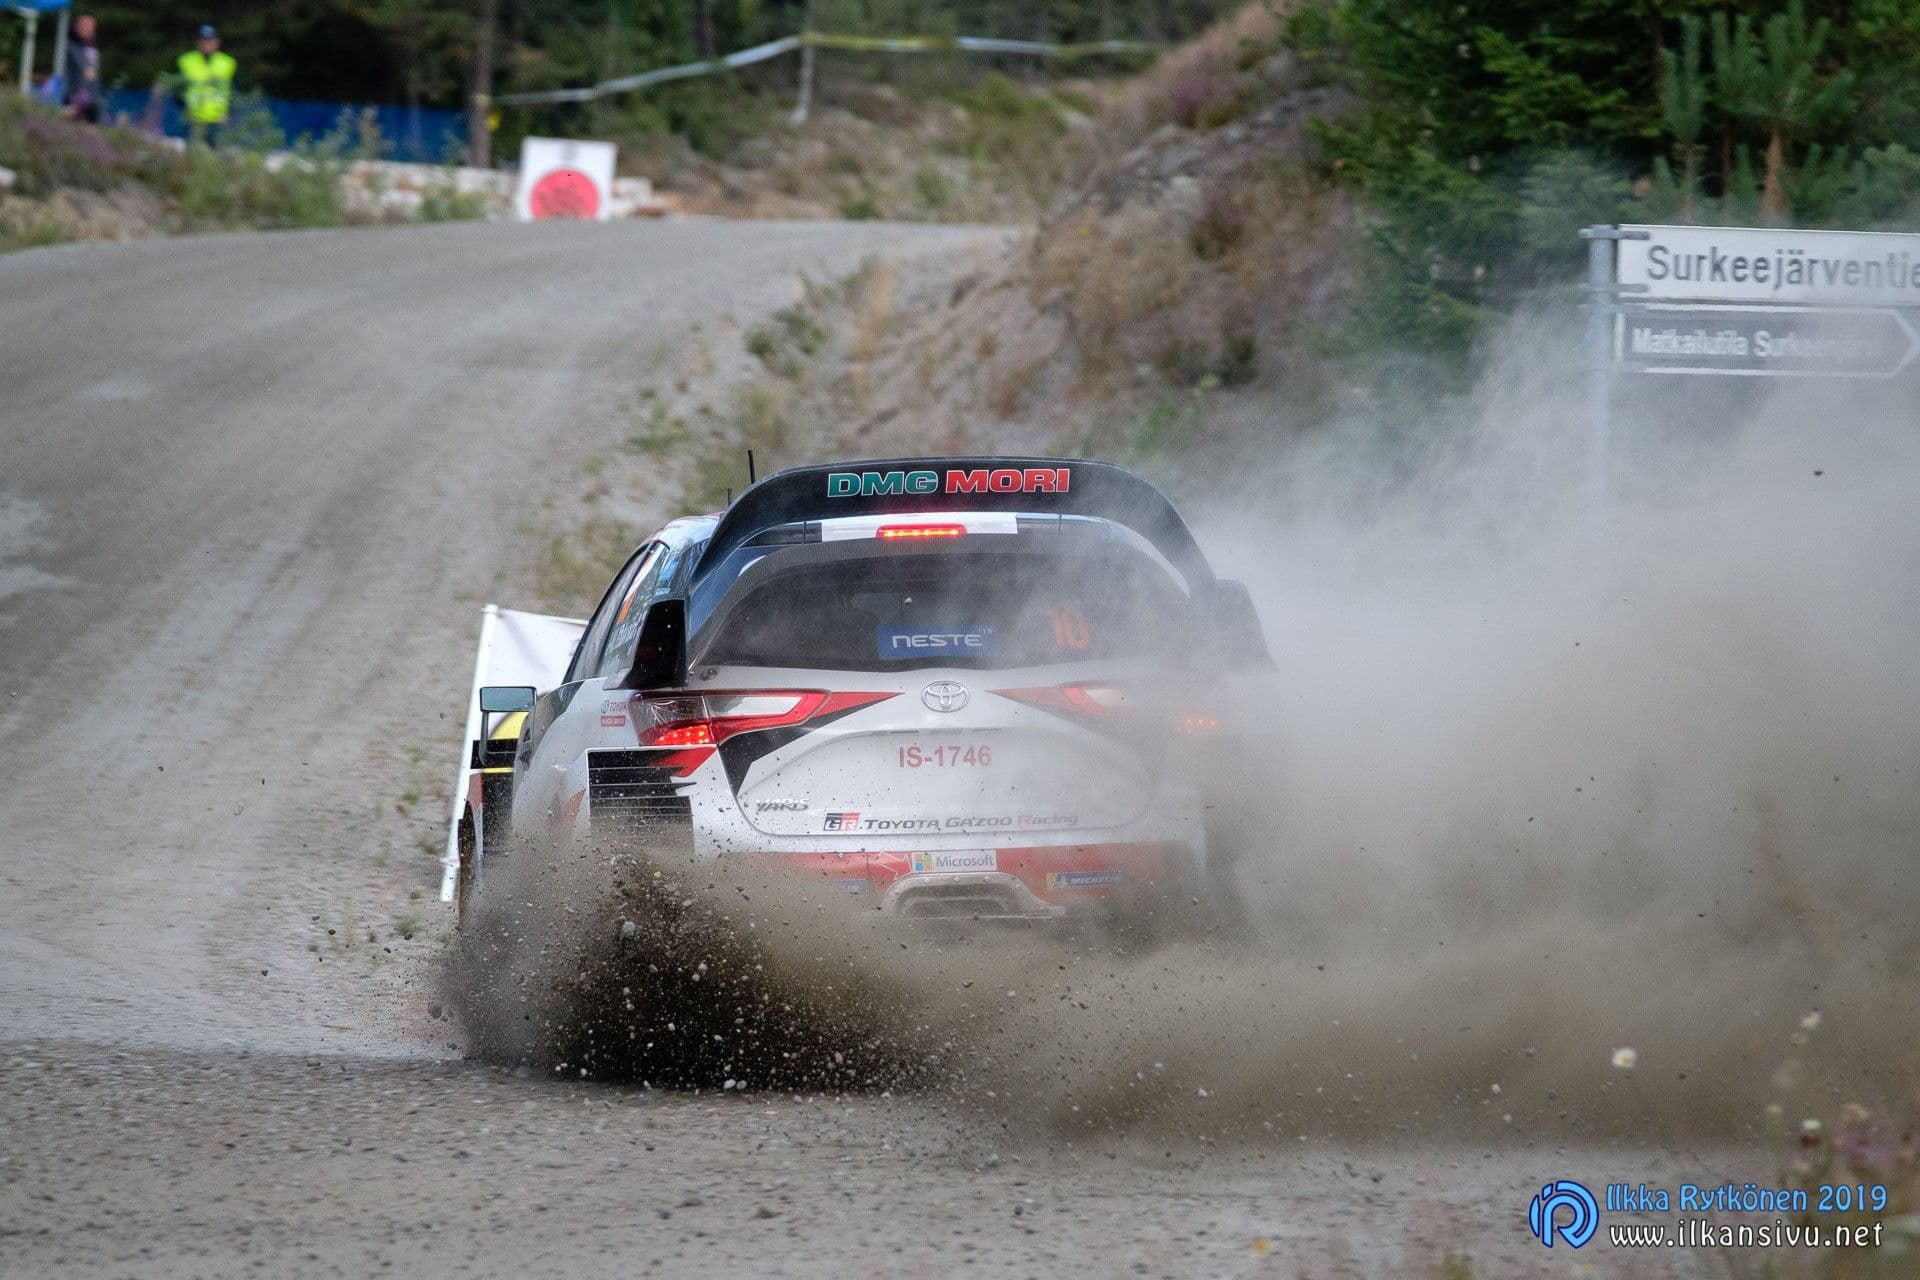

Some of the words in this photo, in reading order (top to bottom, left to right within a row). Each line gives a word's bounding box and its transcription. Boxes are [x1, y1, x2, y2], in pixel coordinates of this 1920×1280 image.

[827, 470, 938, 498] DMG
[945, 468, 1070, 493] MORI
[897, 745, 992, 768] IS-1746
[755, 799, 809, 811] YARIS
[946, 816, 1012, 828] GAZOO
[1017, 813, 1079, 828] Racing
[936, 854, 994, 868] Microsoft
